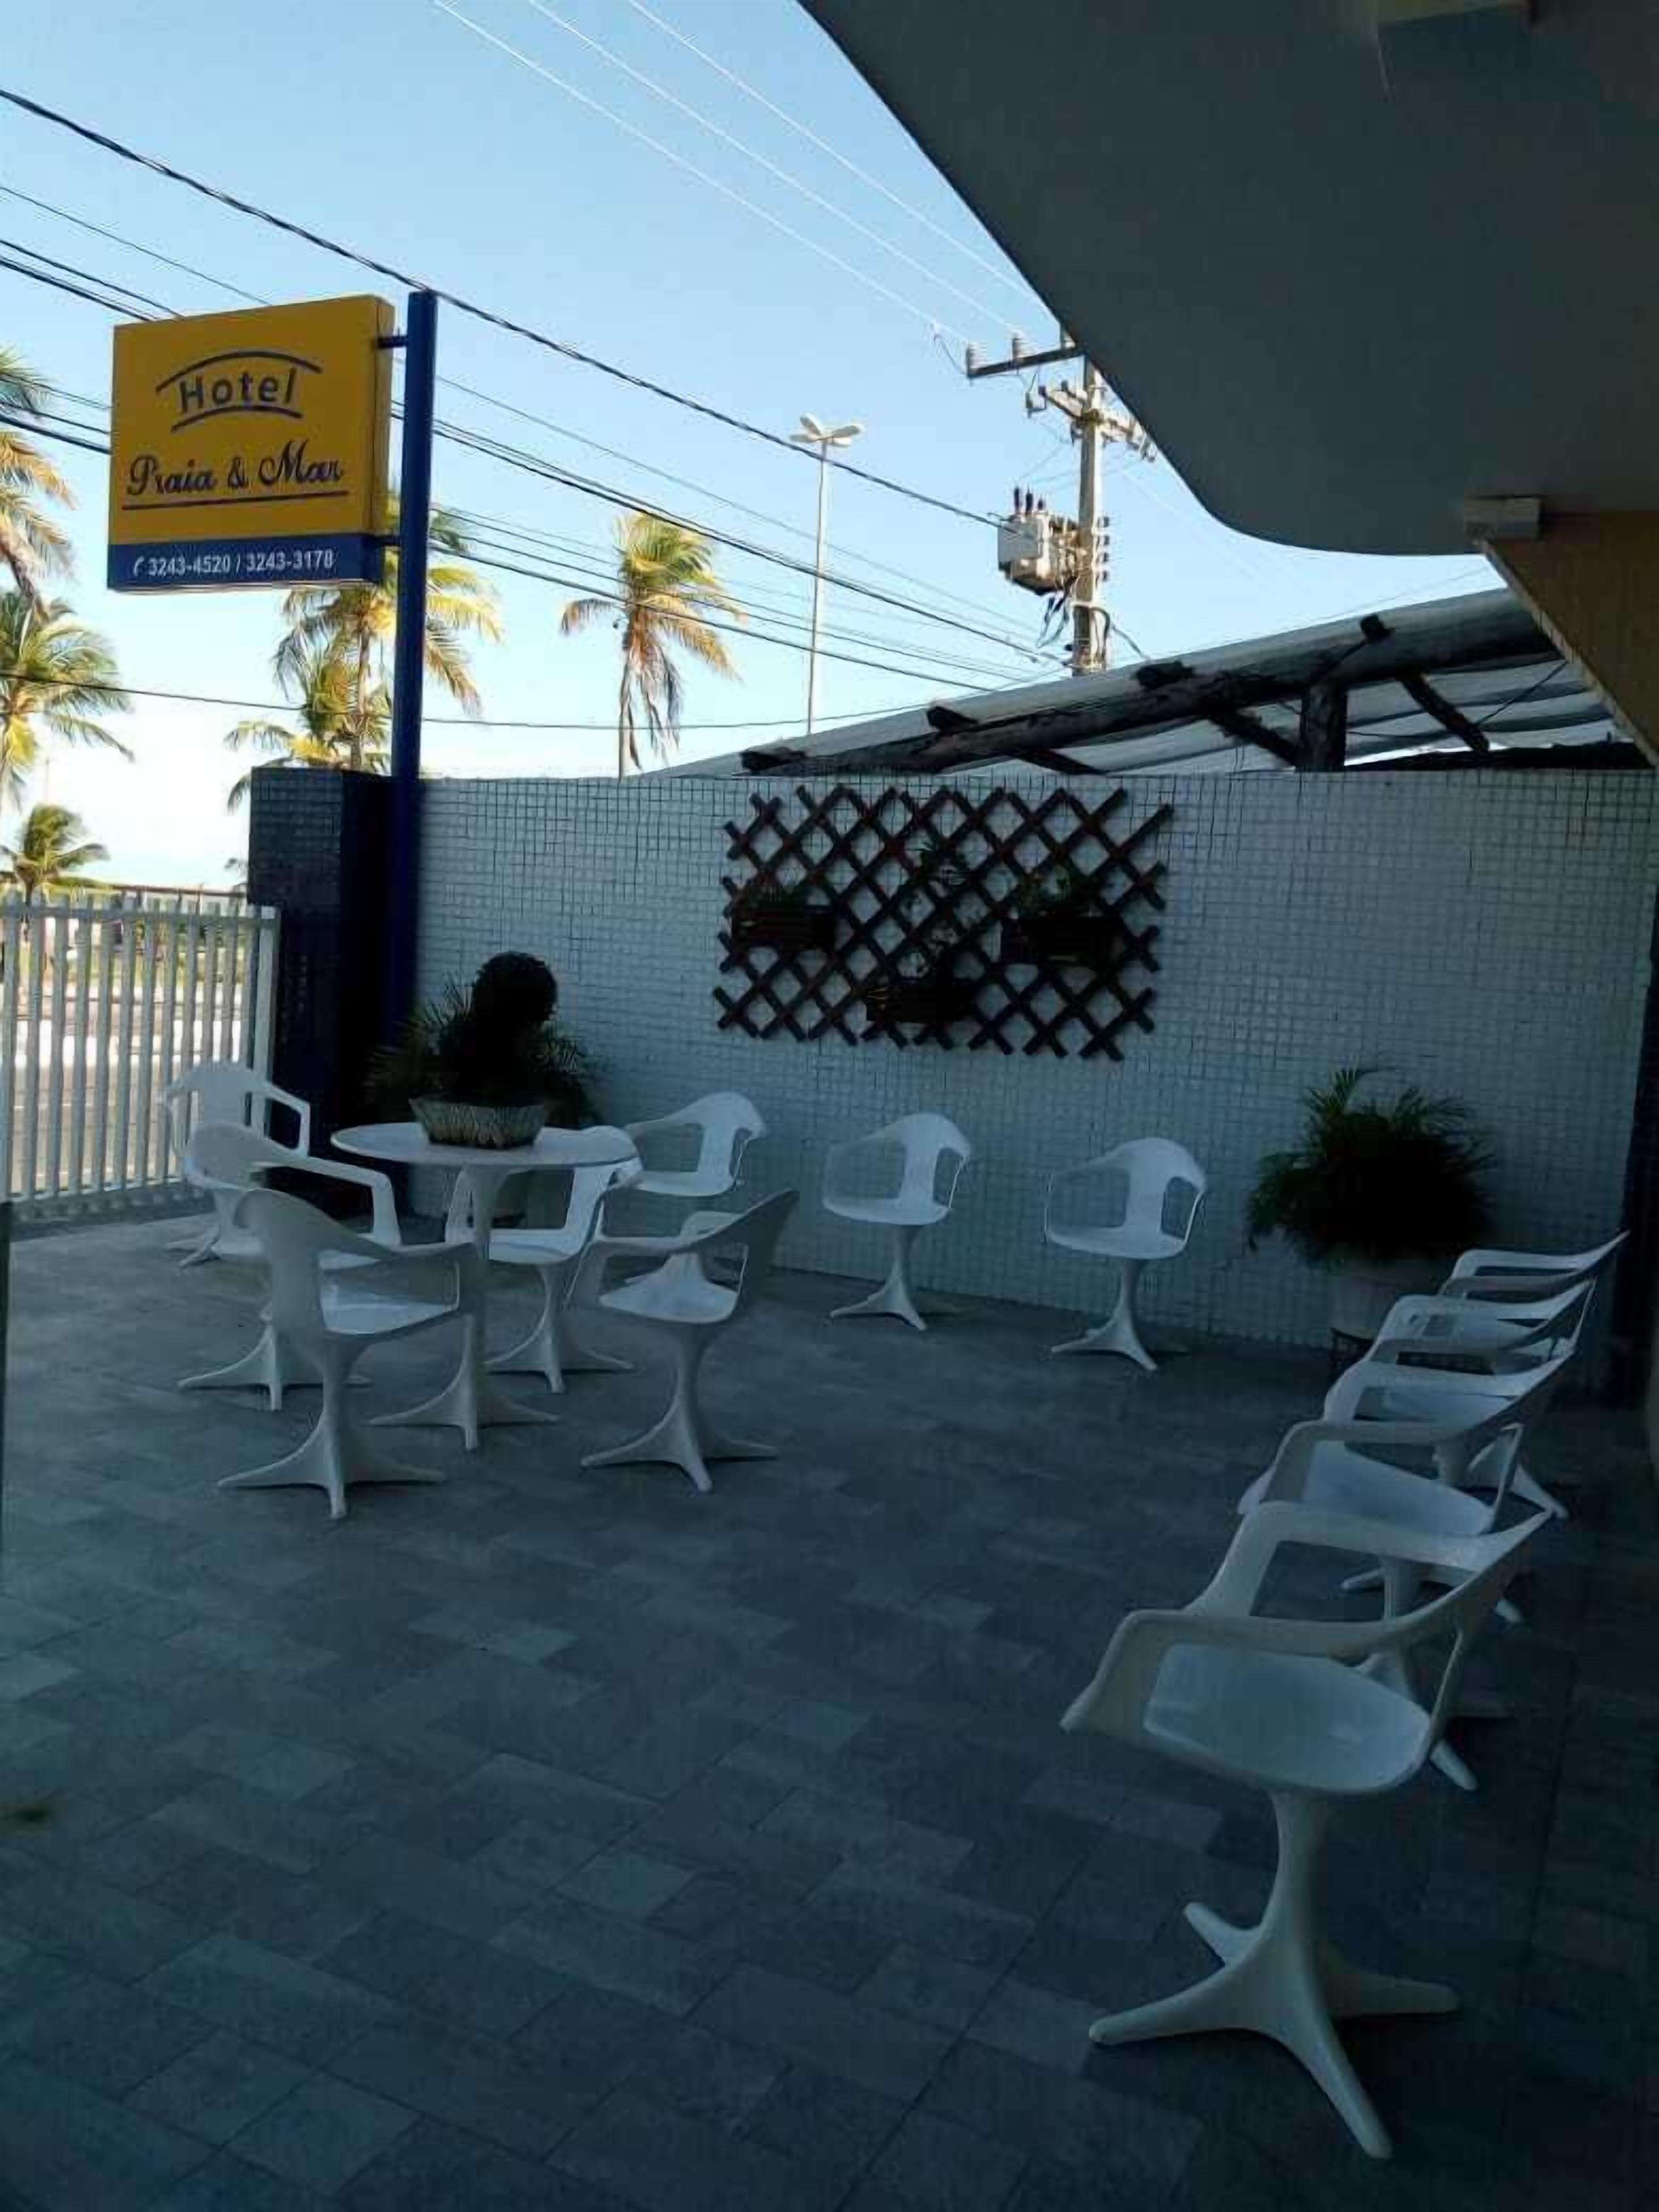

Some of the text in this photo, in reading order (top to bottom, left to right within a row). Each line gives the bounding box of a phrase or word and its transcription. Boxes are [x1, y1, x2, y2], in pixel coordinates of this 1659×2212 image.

[179, 368, 297, 413] Hotel
[127, 438, 343, 496] Praia & Mar
[148, 555, 230, 576] 3243-4520
